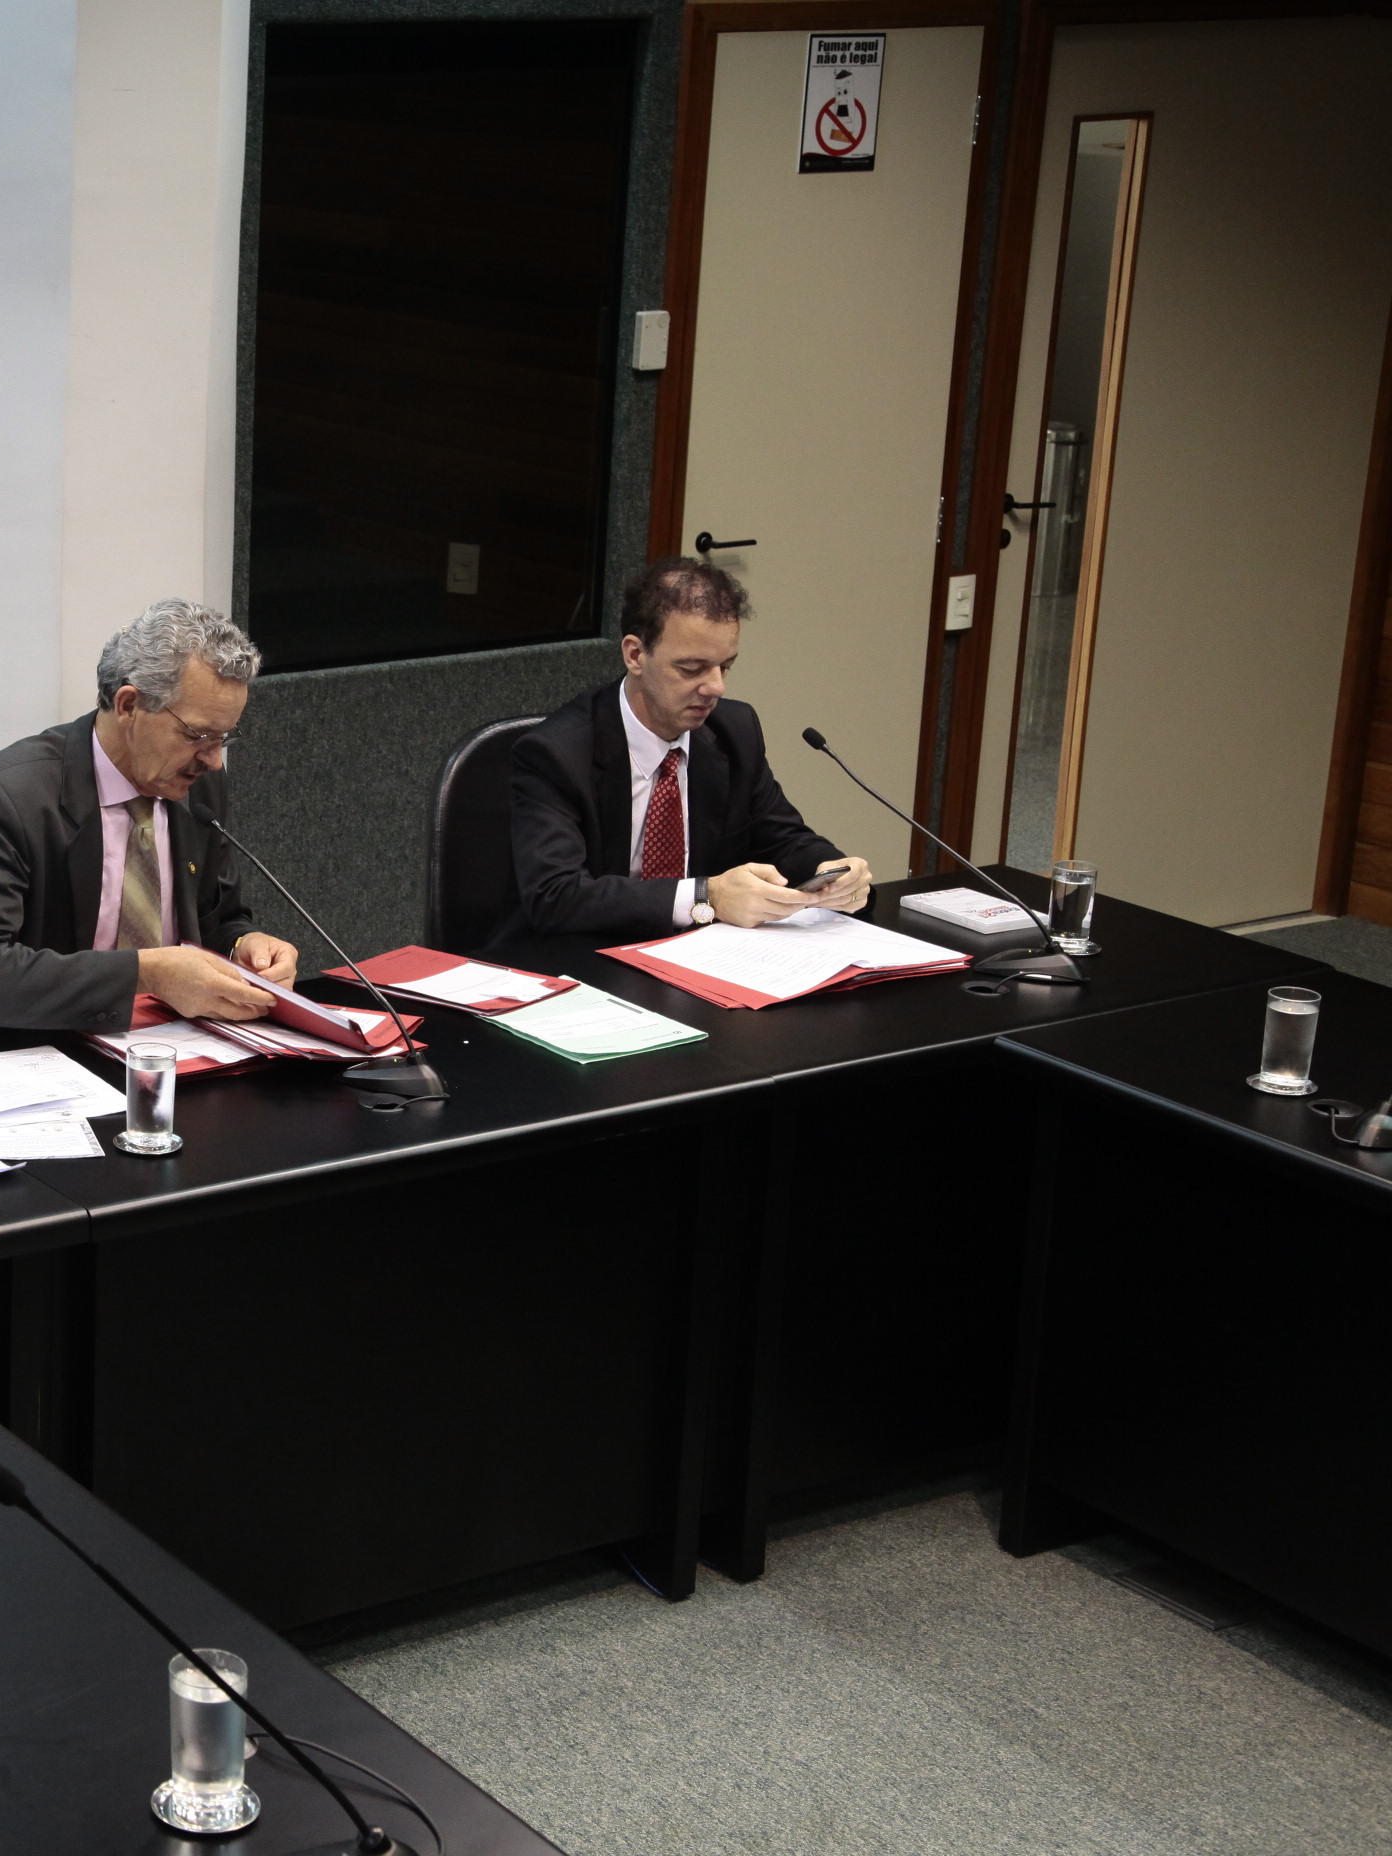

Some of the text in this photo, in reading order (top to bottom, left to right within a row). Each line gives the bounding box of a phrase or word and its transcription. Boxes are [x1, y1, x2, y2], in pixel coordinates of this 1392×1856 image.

[818, 40, 879, 52] Fumar aqui
[816, 52, 878, 64] não é legal
